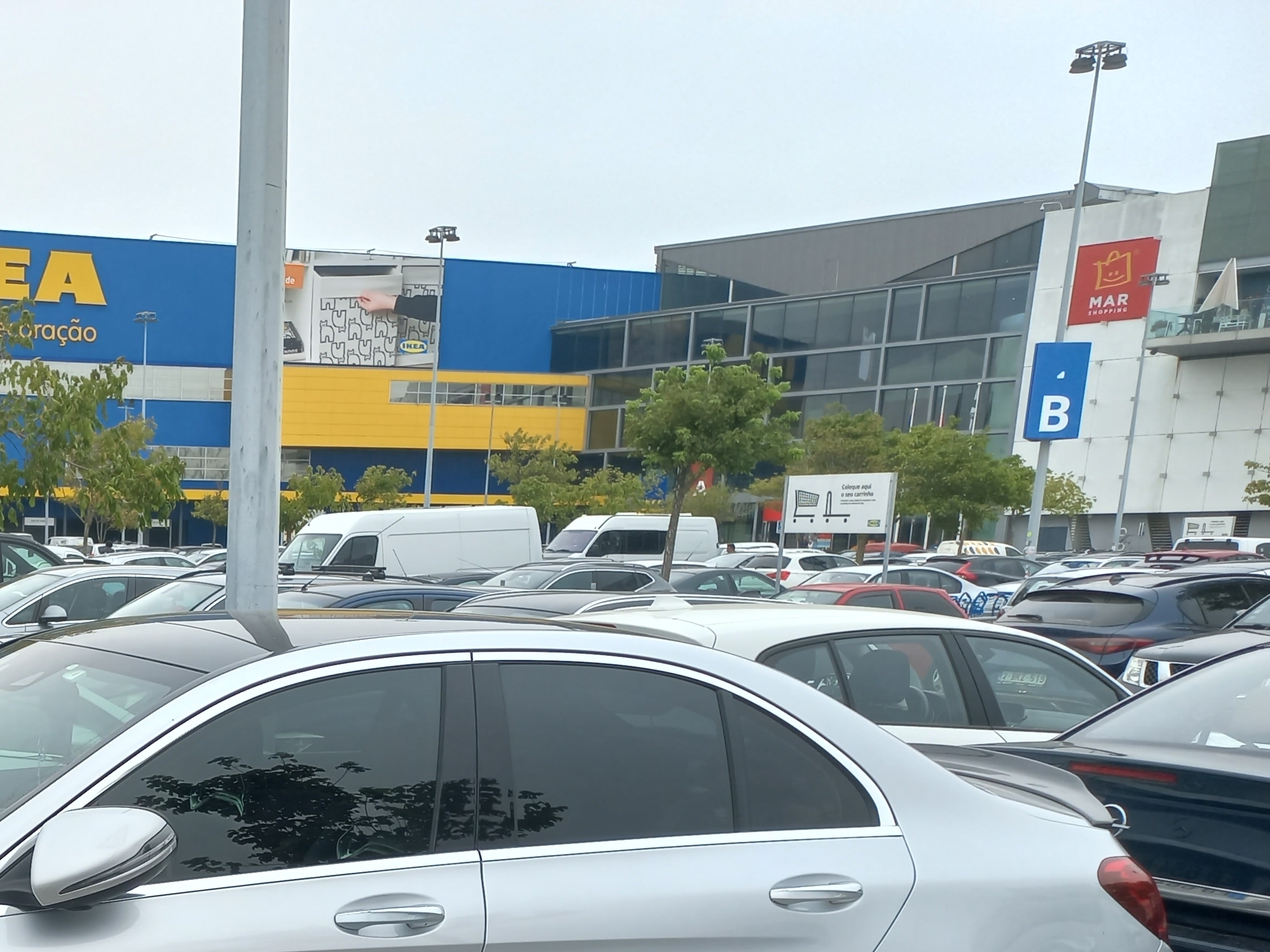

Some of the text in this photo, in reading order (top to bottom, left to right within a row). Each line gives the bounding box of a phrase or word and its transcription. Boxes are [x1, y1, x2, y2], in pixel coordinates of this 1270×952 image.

[1088, 293, 1129, 309] MAR
[1088, 307, 1128, 316] SHOPPING
[1038, 395, 1071, 433] B
